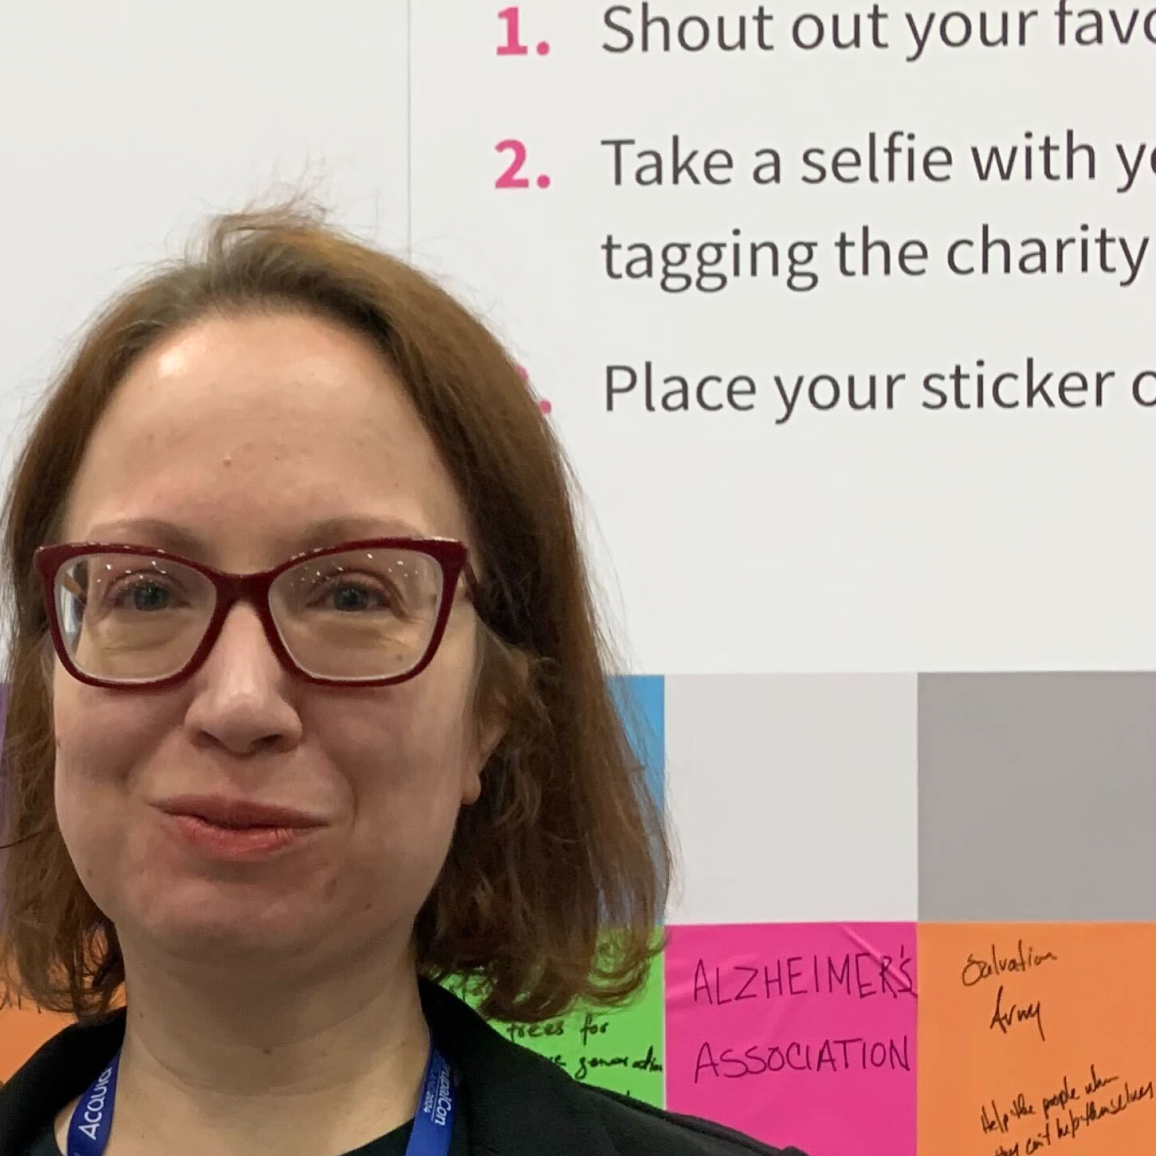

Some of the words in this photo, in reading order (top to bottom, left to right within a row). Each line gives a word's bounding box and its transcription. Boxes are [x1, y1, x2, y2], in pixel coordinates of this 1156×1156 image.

[495, 7, 551, 56] 1.
[601, 4, 774, 54] Shout
[791, 9, 890, 50] out
[906, 10, 1039, 62] your
[494, 139, 552, 190] 2.
[601, 135, 734, 187] Take
[753, 145, 781, 185] a
[801, 131, 953, 184] selfie
[971, 129, 1097, 182] with
[601, 228, 819, 293] tagging
[835, 225, 928, 277] the
[946, 223, 1149, 287] charity
[606, 361, 756, 412] Place
[775, 372, 905, 424] your
[921, 358, 1115, 410] sticker
[694, 944, 917, 1005] ALZHEIMER'S
[962, 939, 1057, 987] Salvation
[580, 1013, 609, 1046] for
[990, 985, 1045, 1042] Army
[694, 1035, 910, 1083] ASSOCIATION
[981, 1100, 1009, 1134] Help
